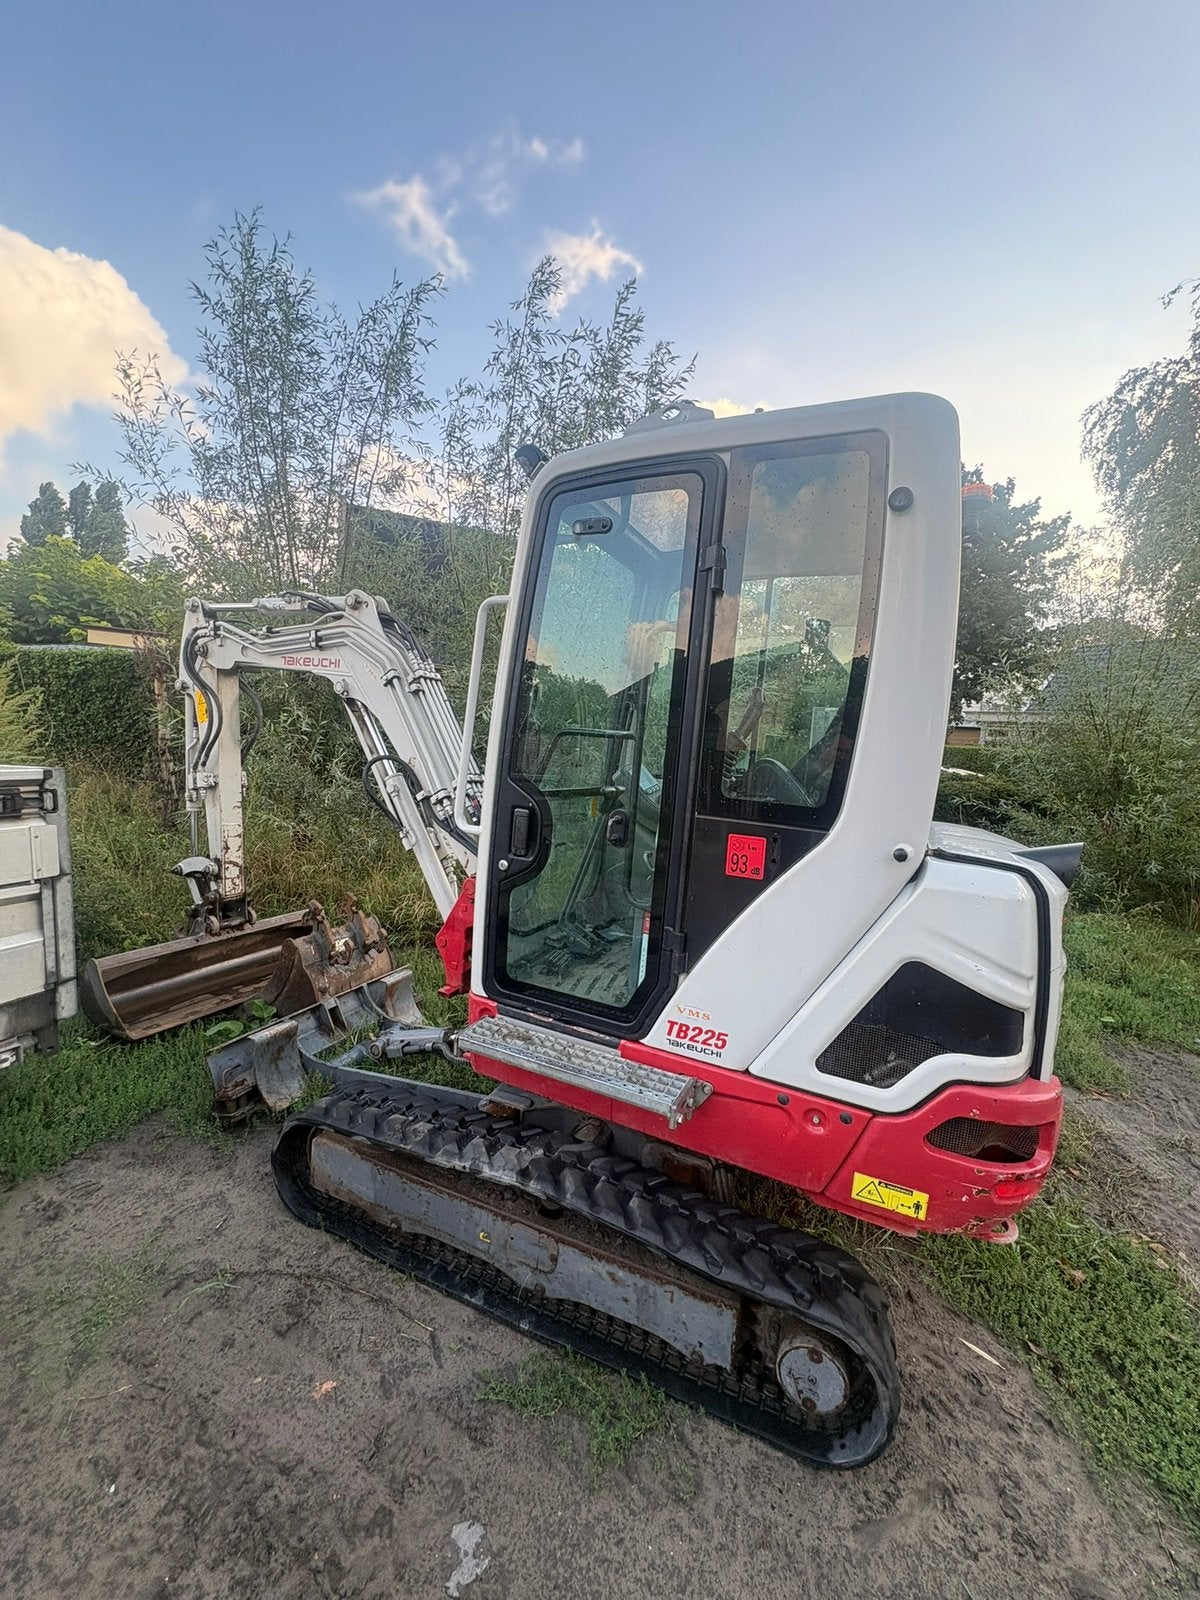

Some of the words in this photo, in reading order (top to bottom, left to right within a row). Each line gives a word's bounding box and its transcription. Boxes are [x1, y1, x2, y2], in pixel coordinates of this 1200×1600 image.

[731, 852, 748, 874] 93
[750, 866, 761, 876] dB
[675, 1006, 711, 1021] VMS
[666, 1019, 729, 1050] TB225
